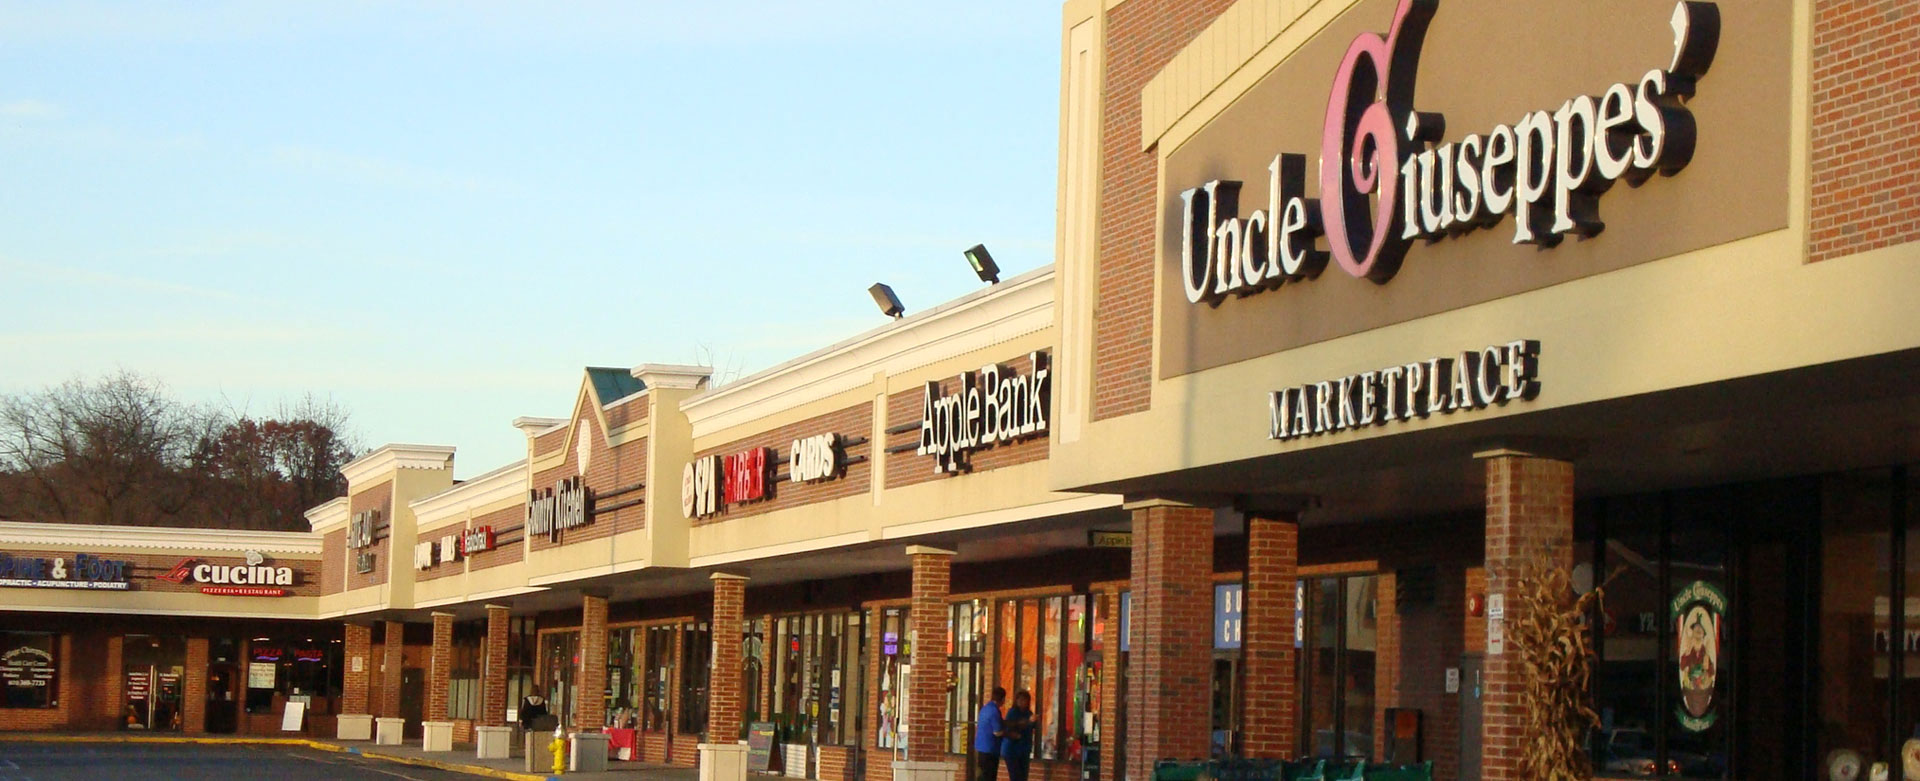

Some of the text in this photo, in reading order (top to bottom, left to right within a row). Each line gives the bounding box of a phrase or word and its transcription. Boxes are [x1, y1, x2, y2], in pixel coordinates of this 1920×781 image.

[1180, 153, 1307, 304] Uncle
[917, 351, 1048, 474] Apple Bank
[1267, 339, 1528, 440] MARKETPLACE
[789, 431, 836, 483] CARDS
[555, 475, 587, 529] Kitchen
[37, 580, 89, 588] ACUPUNCTURE
[93, 581, 128, 589] PODIATRY
[51, 557, 68, 579] &
[155, 557, 293, 585] La cucina
[253, 648, 283, 657] PIZZA
